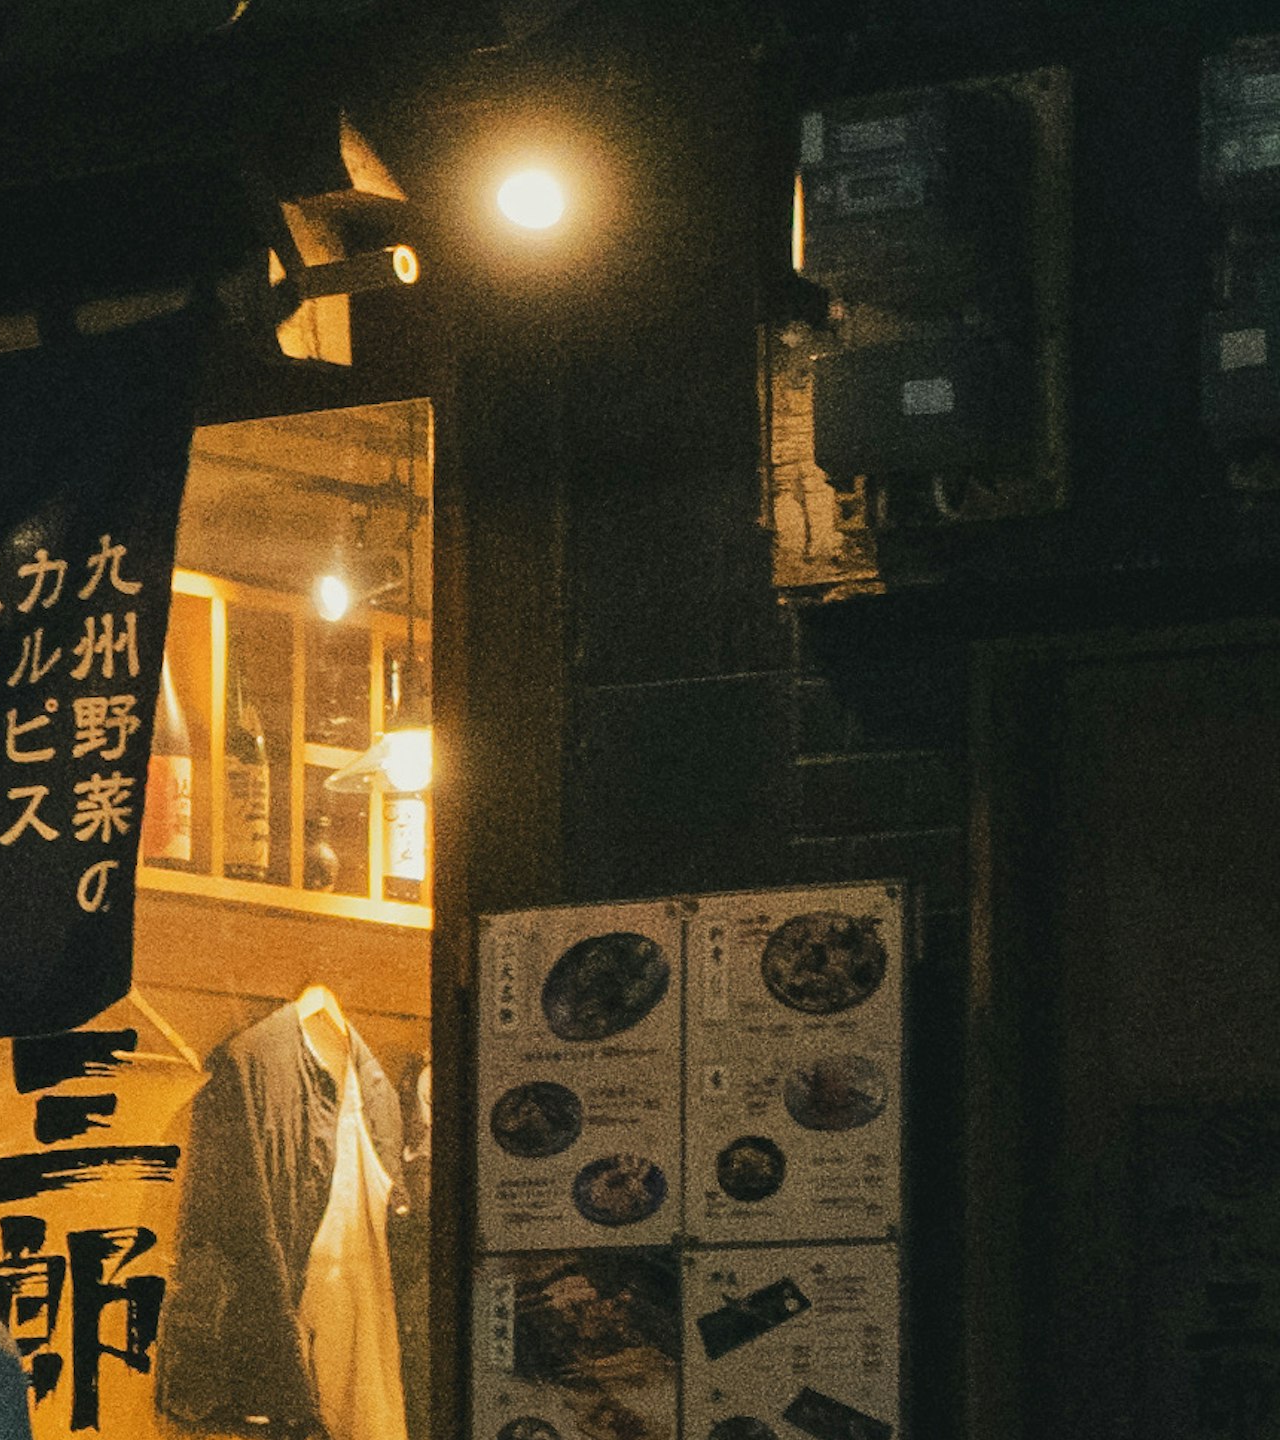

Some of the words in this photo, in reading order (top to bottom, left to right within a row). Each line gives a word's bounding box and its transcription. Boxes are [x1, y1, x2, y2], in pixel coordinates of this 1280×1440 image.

[69, 534, 141, 914] 九州野菜の
